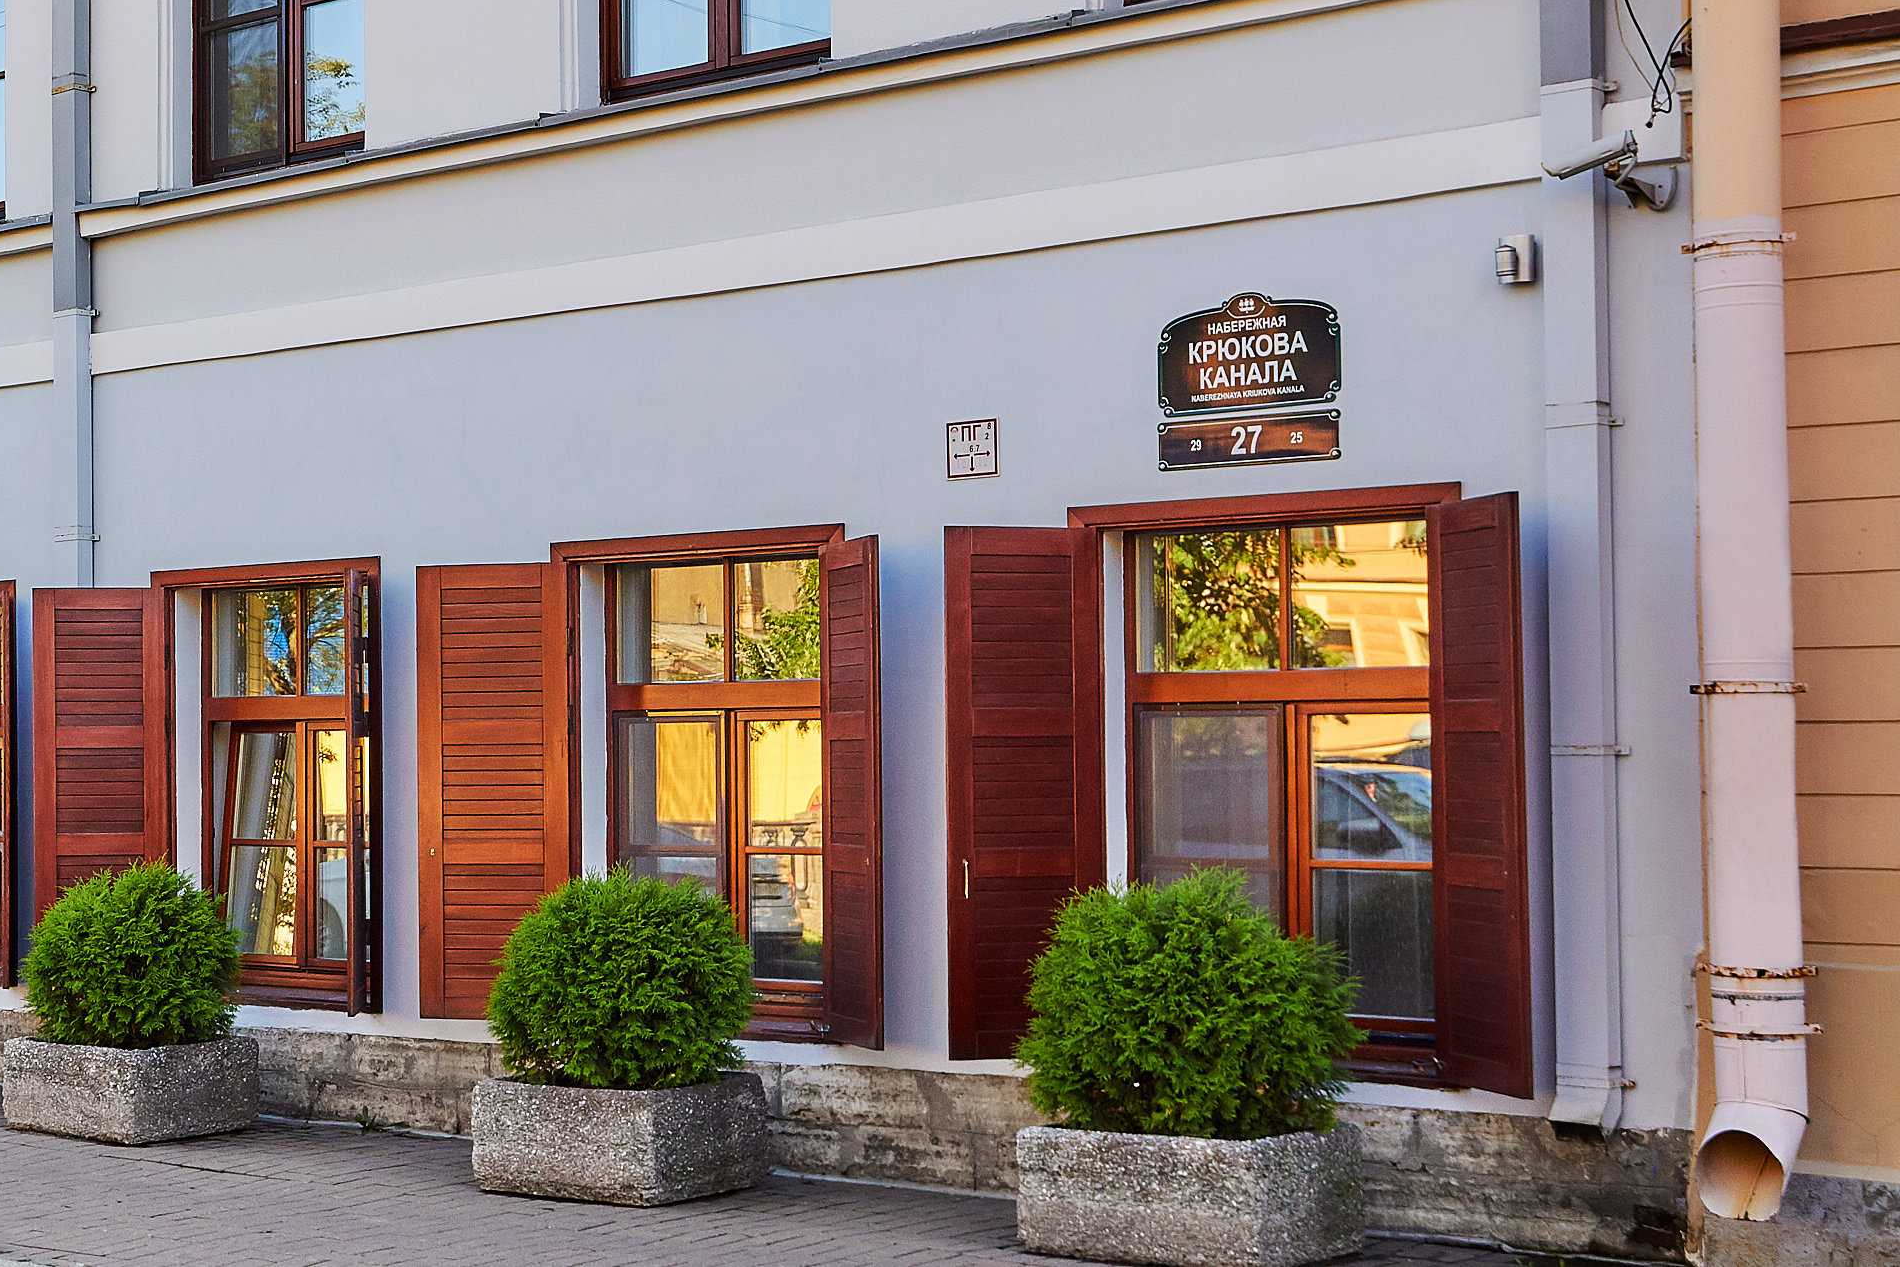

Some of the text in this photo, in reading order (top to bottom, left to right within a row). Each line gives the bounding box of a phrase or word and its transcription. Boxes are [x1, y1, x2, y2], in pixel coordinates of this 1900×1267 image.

[1207, 315, 1287, 335] НАБЕРЕЖНАЯ
[1188, 331, 1308, 364] КРЮКОВА
[1200, 359, 1298, 390] КАНАЛА
[1191, 392, 1242, 403] NABEREZHNAYA
[1276, 384, 1305, 395] KANALA
[961, 424, 981, 442] ПГ
[1230, 425, 1263, 456] 27
[1290, 432, 1303, 444] 25
[1190, 439, 1202, 452] 29
